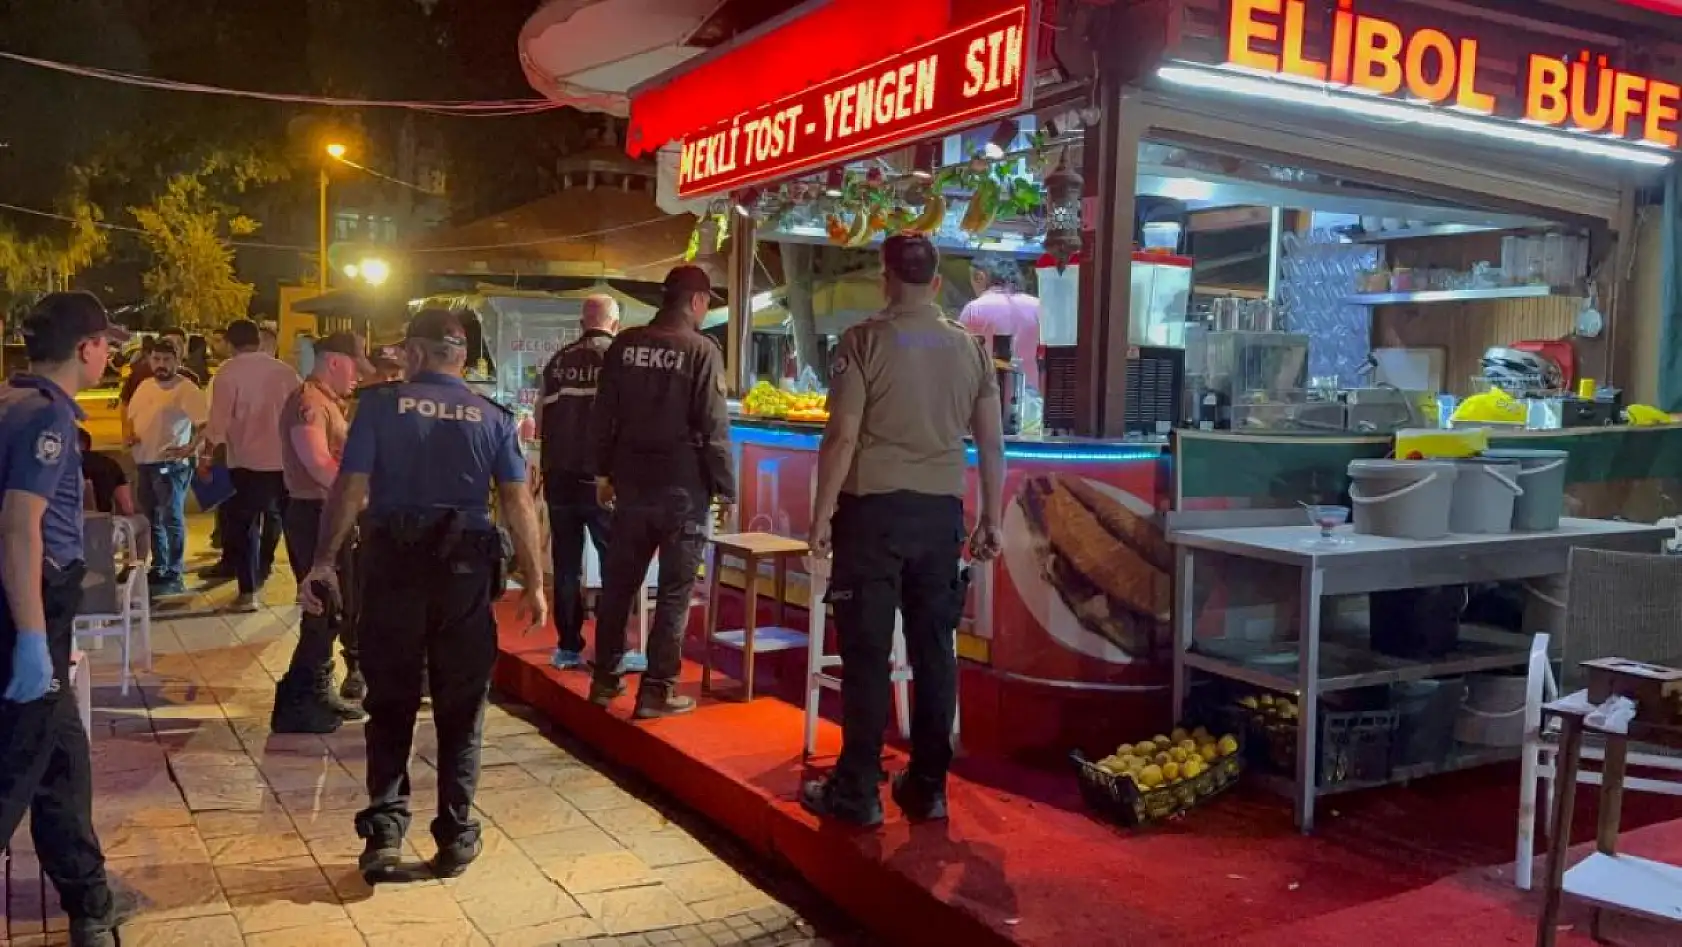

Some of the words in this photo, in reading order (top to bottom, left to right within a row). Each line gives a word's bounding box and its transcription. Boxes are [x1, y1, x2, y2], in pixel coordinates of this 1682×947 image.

[743, 104, 804, 166] TOST
[823, 54, 939, 142] YENGEN
[1228, 0, 1495, 116] ELİBOL
[1526, 48, 1681, 147] BÜFE
